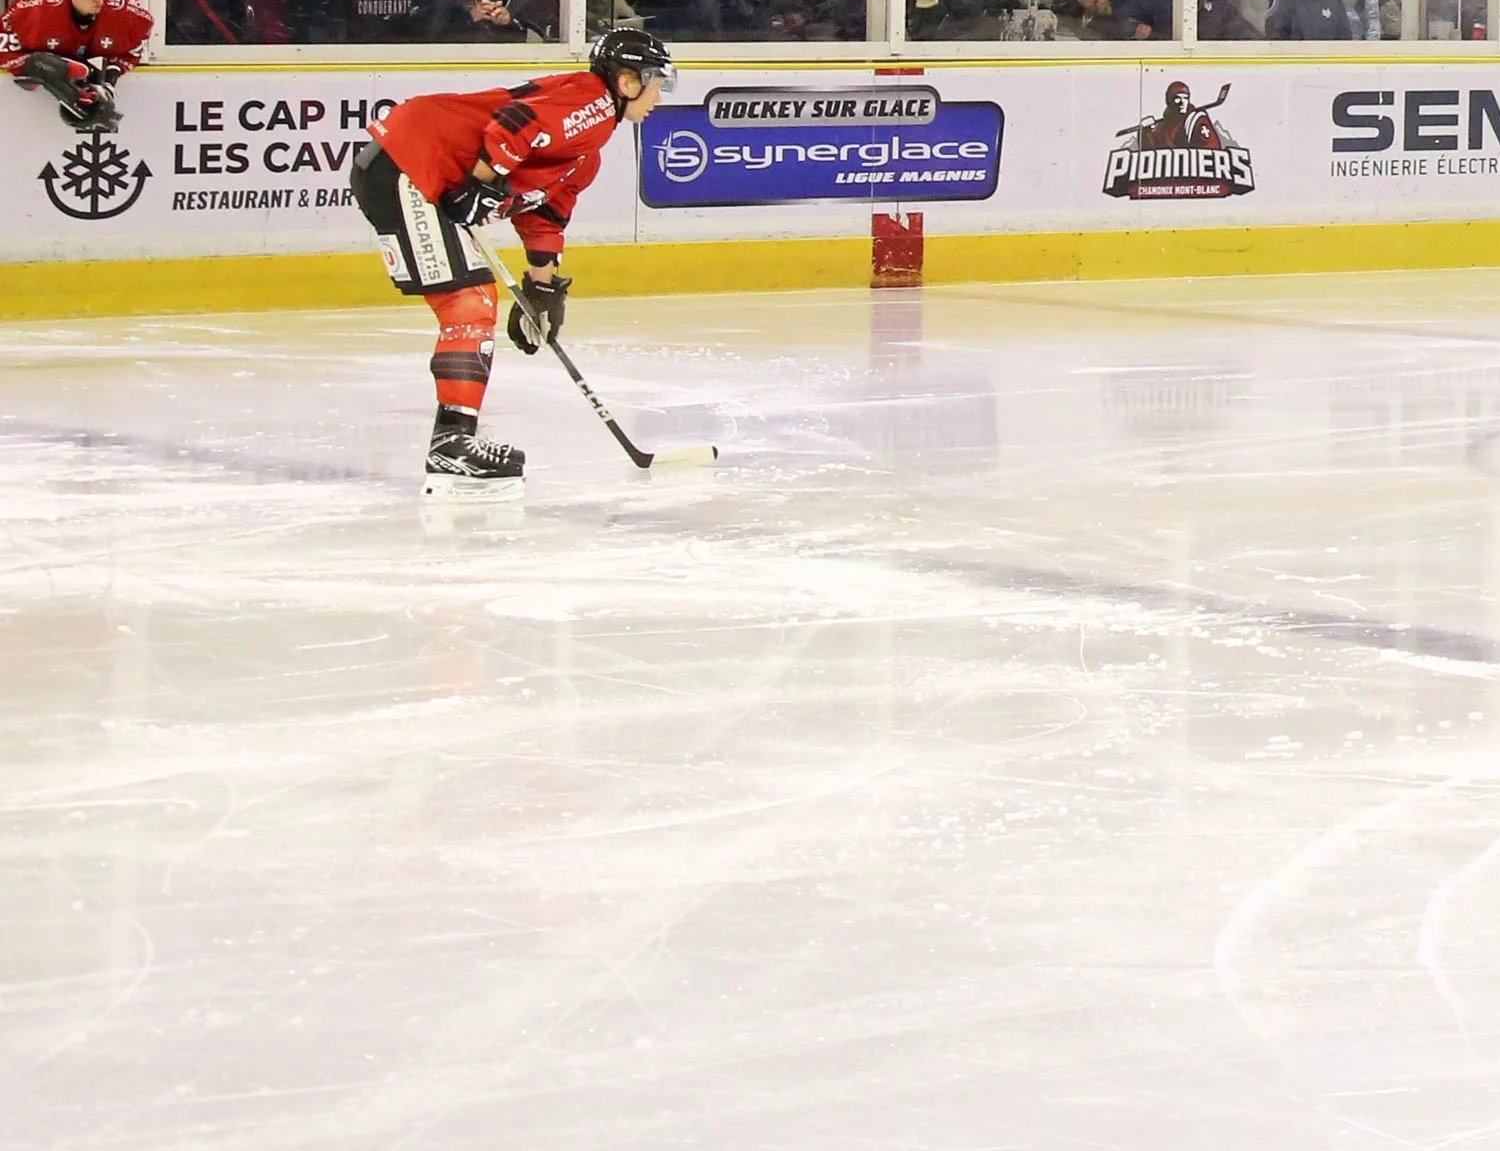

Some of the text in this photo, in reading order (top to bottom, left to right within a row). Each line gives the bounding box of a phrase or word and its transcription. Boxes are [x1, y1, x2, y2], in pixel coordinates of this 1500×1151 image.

[175, 97, 398, 133] LE CAP HO
[562, 90, 615, 132] MONT-BLA
[714, 97, 932, 121] HOCKEY SUR GLACE
[174, 140, 250, 176] LES
[713, 136, 991, 170] synerglace
[1105, 147, 1255, 188] PIONNIERS
[1330, 155, 1428, 177] INGÉNIERIE
[834, 169, 988, 185] LIGUE MAGNUS
[1138, 184, 1221, 196] CHAMONIX MONT-BLANC
[172, 188, 354, 211] RESTAURANT & BAR
